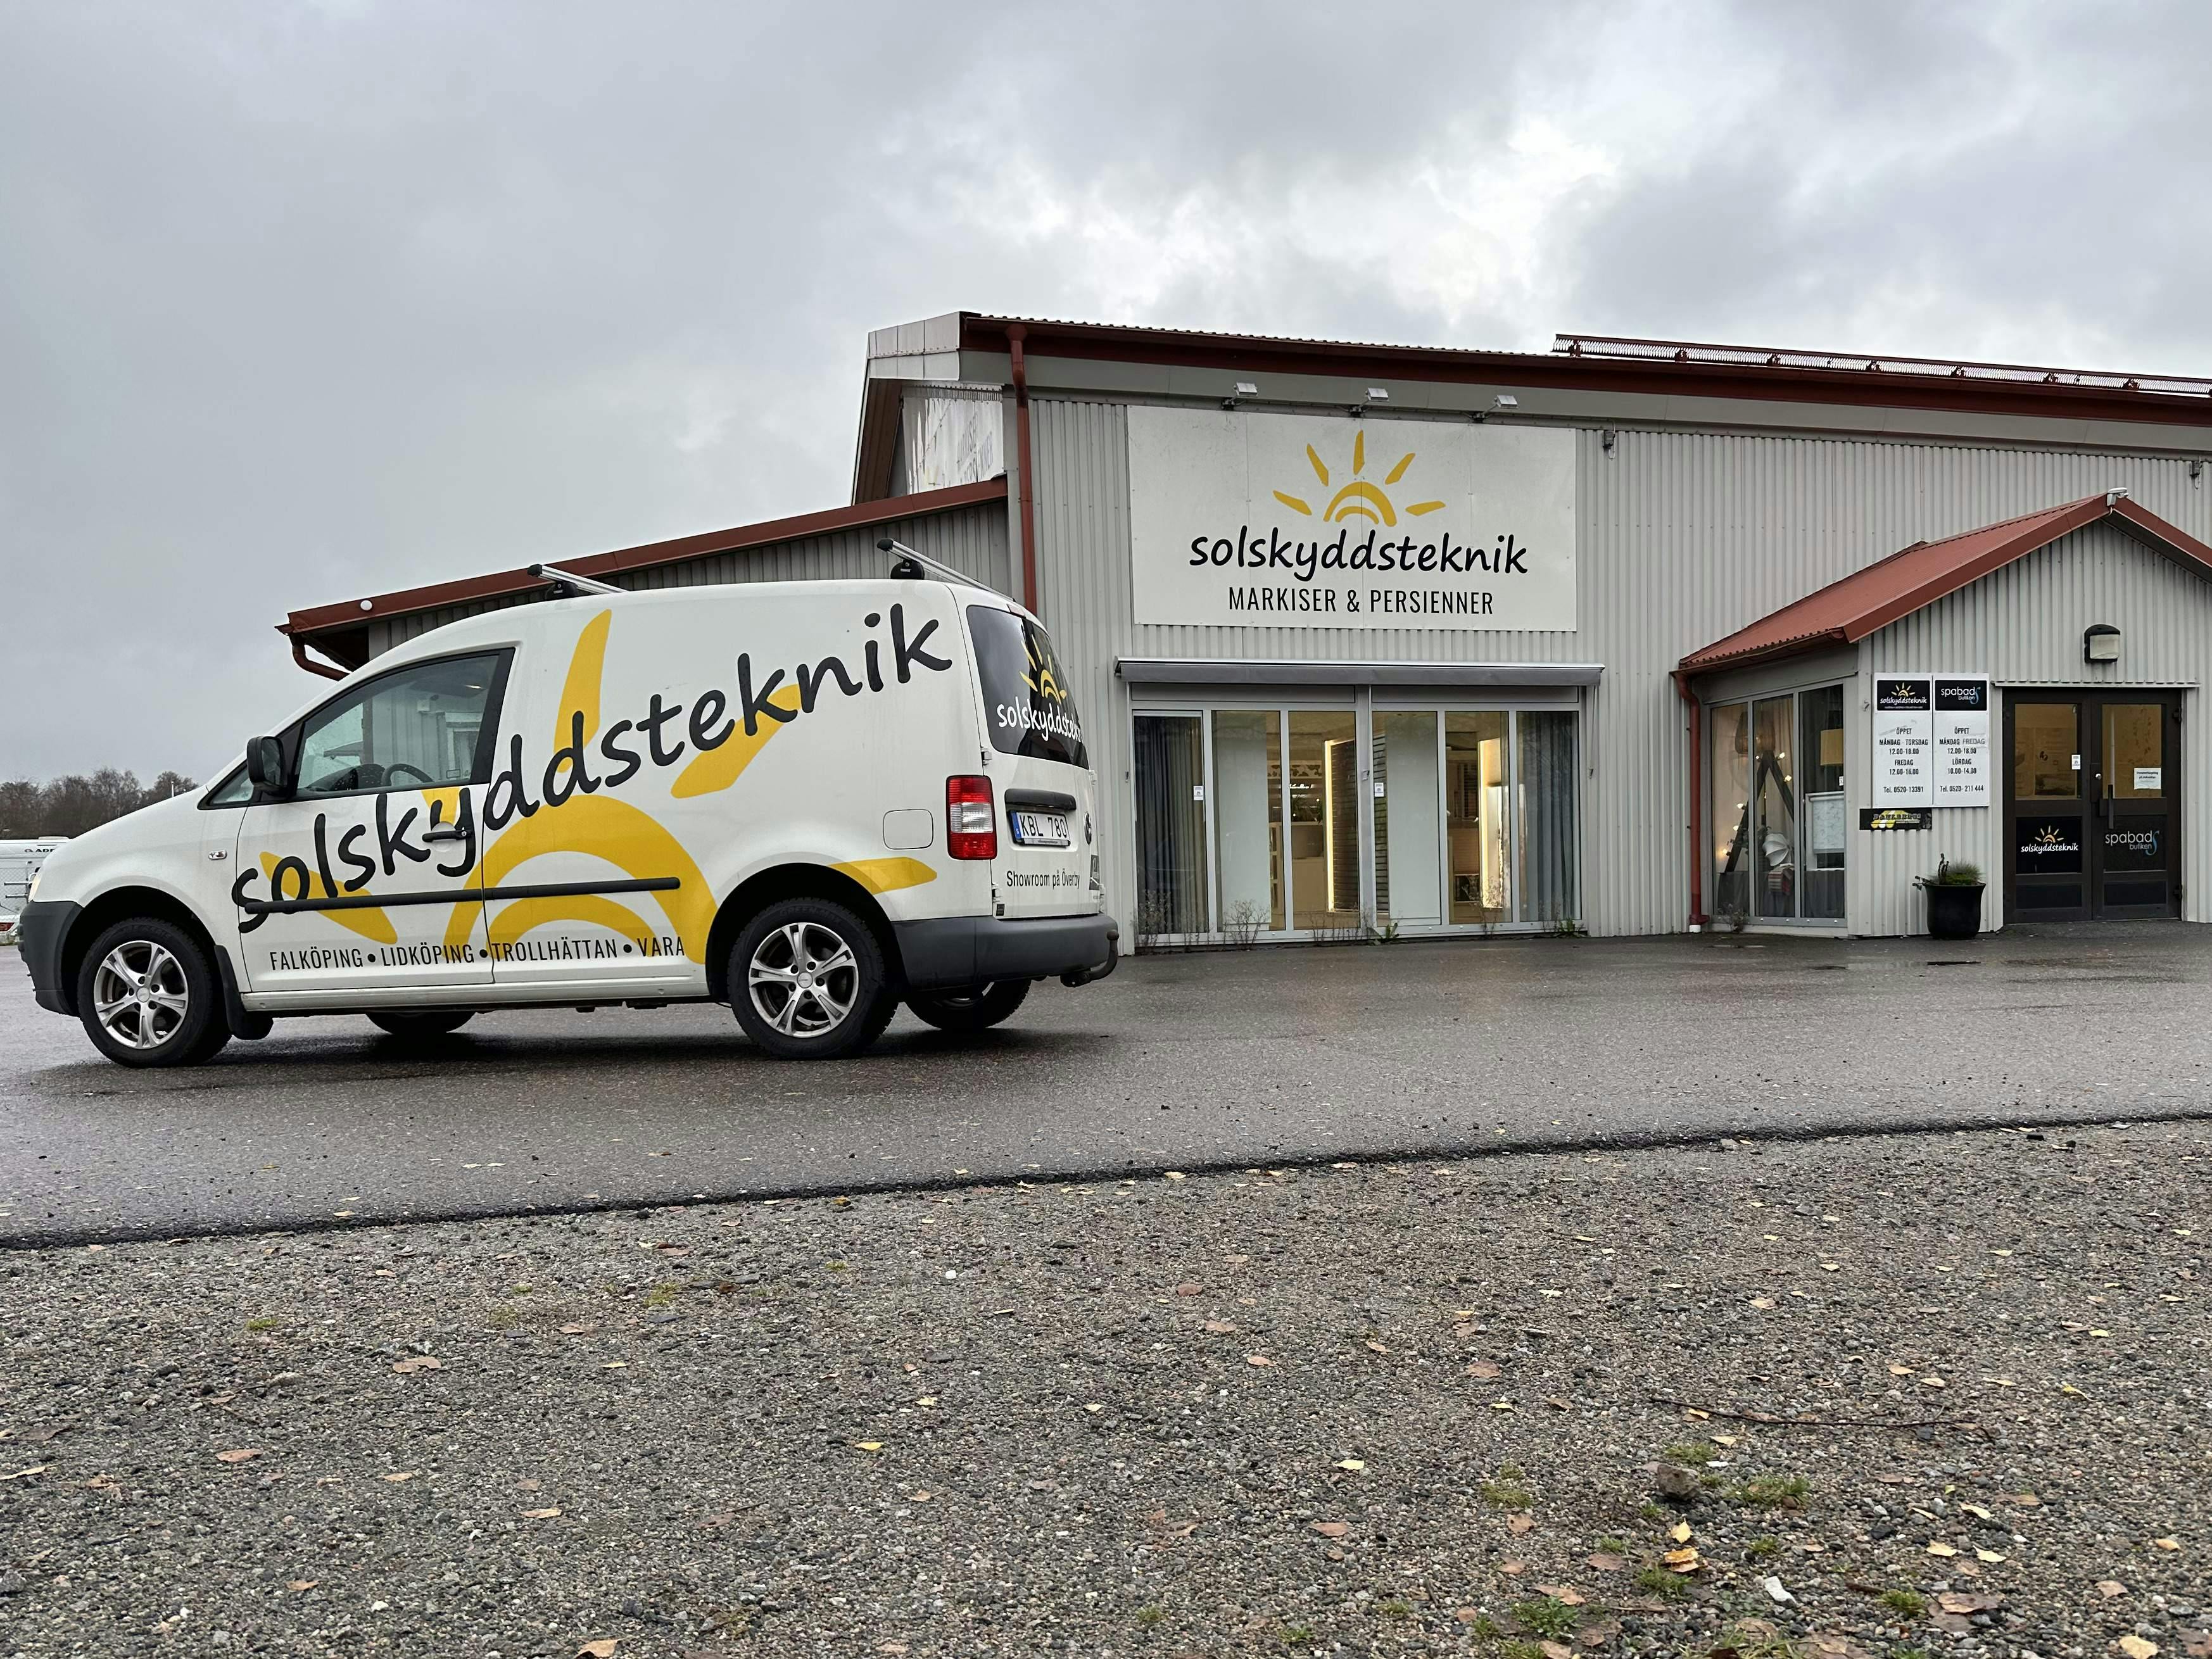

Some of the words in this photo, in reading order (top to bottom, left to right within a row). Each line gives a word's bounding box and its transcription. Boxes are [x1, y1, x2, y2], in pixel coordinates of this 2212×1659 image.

[1189, 525, 1528, 582] solskyddsteknik
[1229, 586, 1337, 612] MARKISER
[1347, 590, 1360, 612] &
[1370, 590, 1493, 615] PERSIENNER
[1880, 696, 1928, 705] solskyddsteknik
[1879, 737, 1900, 745] MÅNDAG
[1896, 726, 1912, 735] ÖPPET
[1954, 726, 1969, 734] ÖPPET
[232, 603, 952, 933] solskyddsteknik
[1019, 814, 1044, 836] KBL
[1047, 817, 1068, 838] 780
[2021, 842, 2079, 854] solskyddsteknik
[1006, 870, 1050, 886] Showroom
[1052, 869, 1060, 890] på
[1061, 867, 1080, 890] Överby
[270, 946, 363, 971] FALKÖPING
[381, 942, 475, 967] LIDKÖPING
[491, 937, 618, 962] TROLLHÄTTAN
[637, 936, 685, 958] VARA
